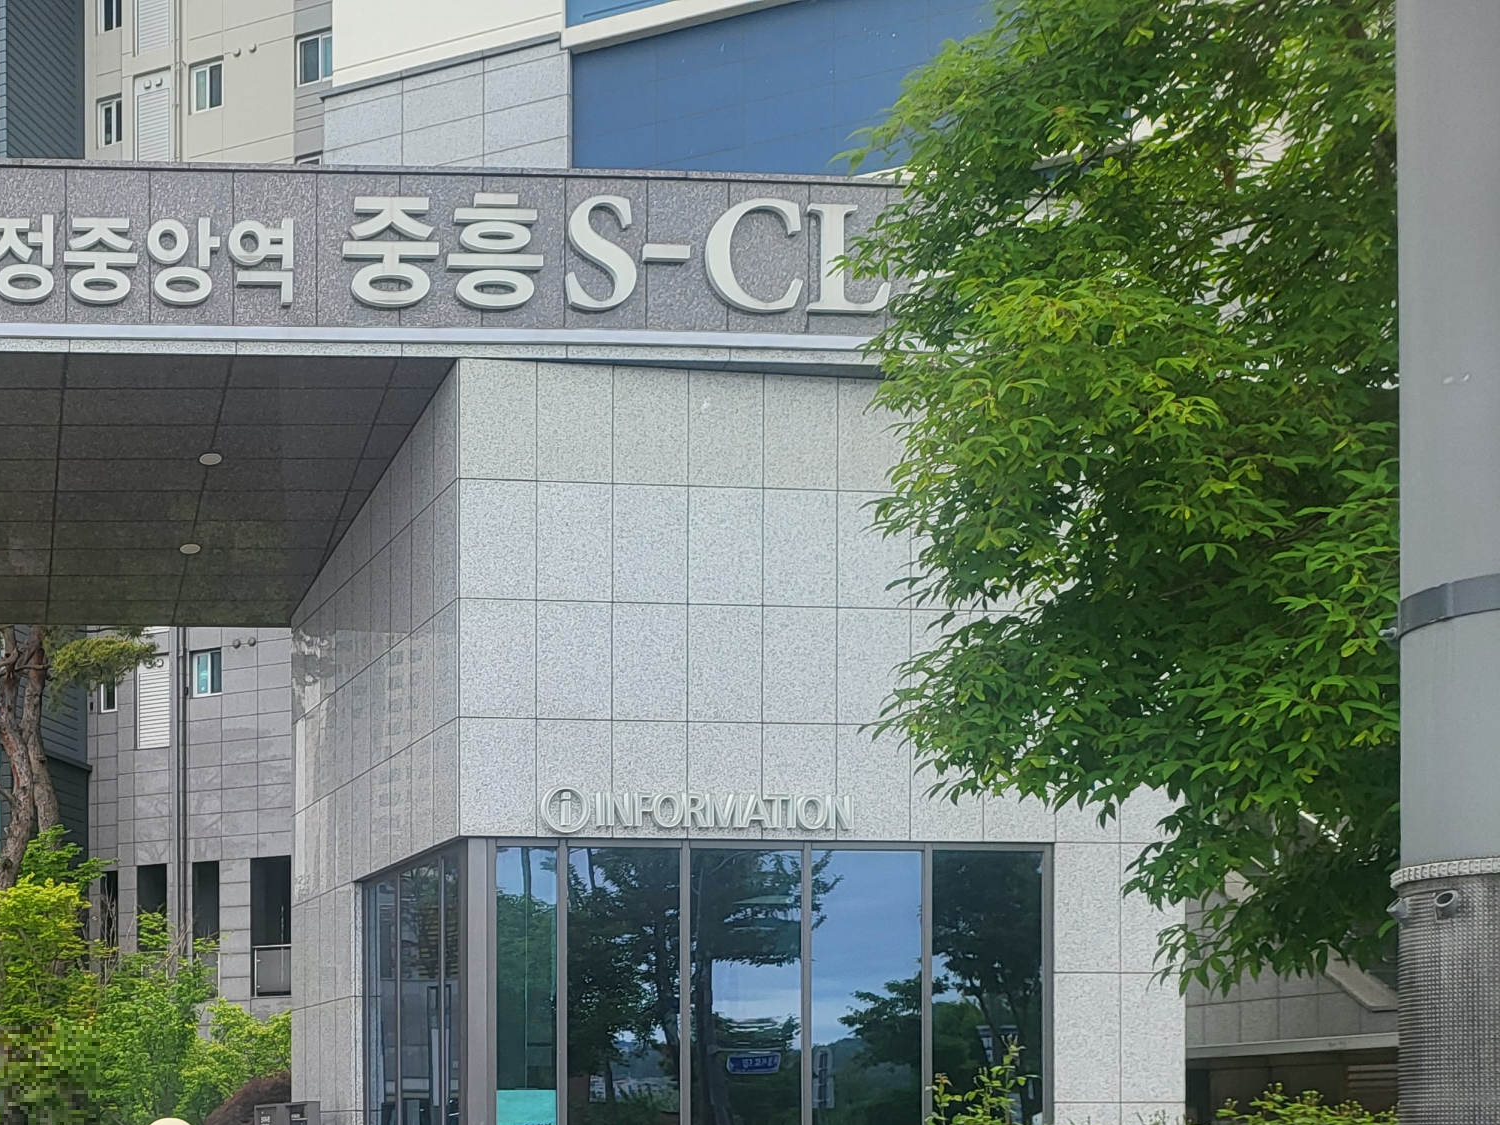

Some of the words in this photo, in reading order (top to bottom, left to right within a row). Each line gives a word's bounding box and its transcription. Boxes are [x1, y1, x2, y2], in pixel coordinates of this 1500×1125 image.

[342, 192, 545, 311] 중흥
[565, 194, 930, 313] S-CL
[595, 791, 855, 831] INFORMATION
